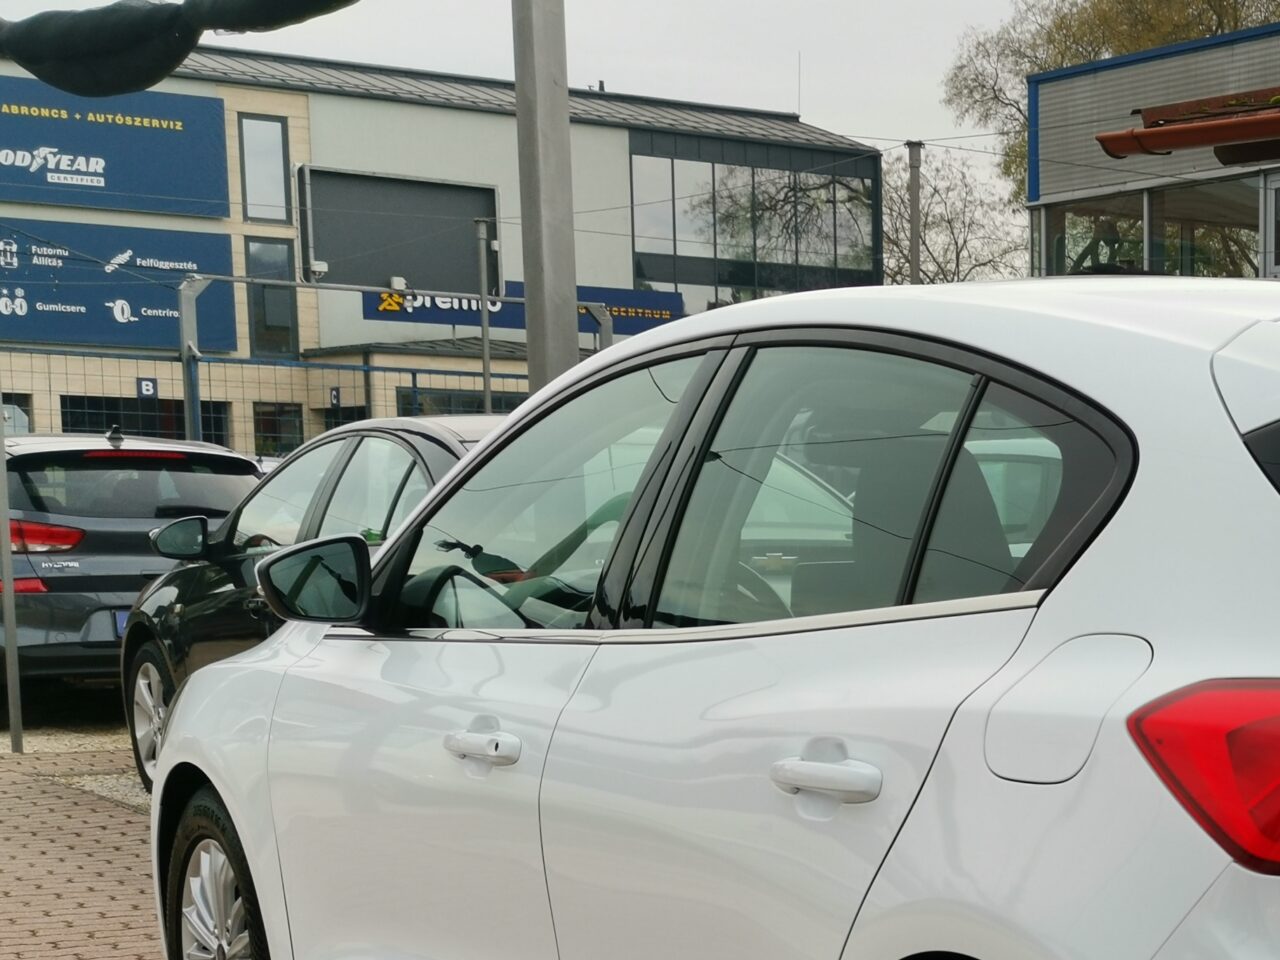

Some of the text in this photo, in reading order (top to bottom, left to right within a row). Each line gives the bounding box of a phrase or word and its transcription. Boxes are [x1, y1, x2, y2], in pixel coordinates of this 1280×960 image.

[1, 103, 69, 119] ABRONCS
[87, 112, 184, 131] AUTÓSZERVIZ
[50, 174, 103, 185] CERTIFIED
[35, 302, 87, 313] Gumicsere
[404, 295, 502, 313] premo
[141, 381, 154, 394] B
